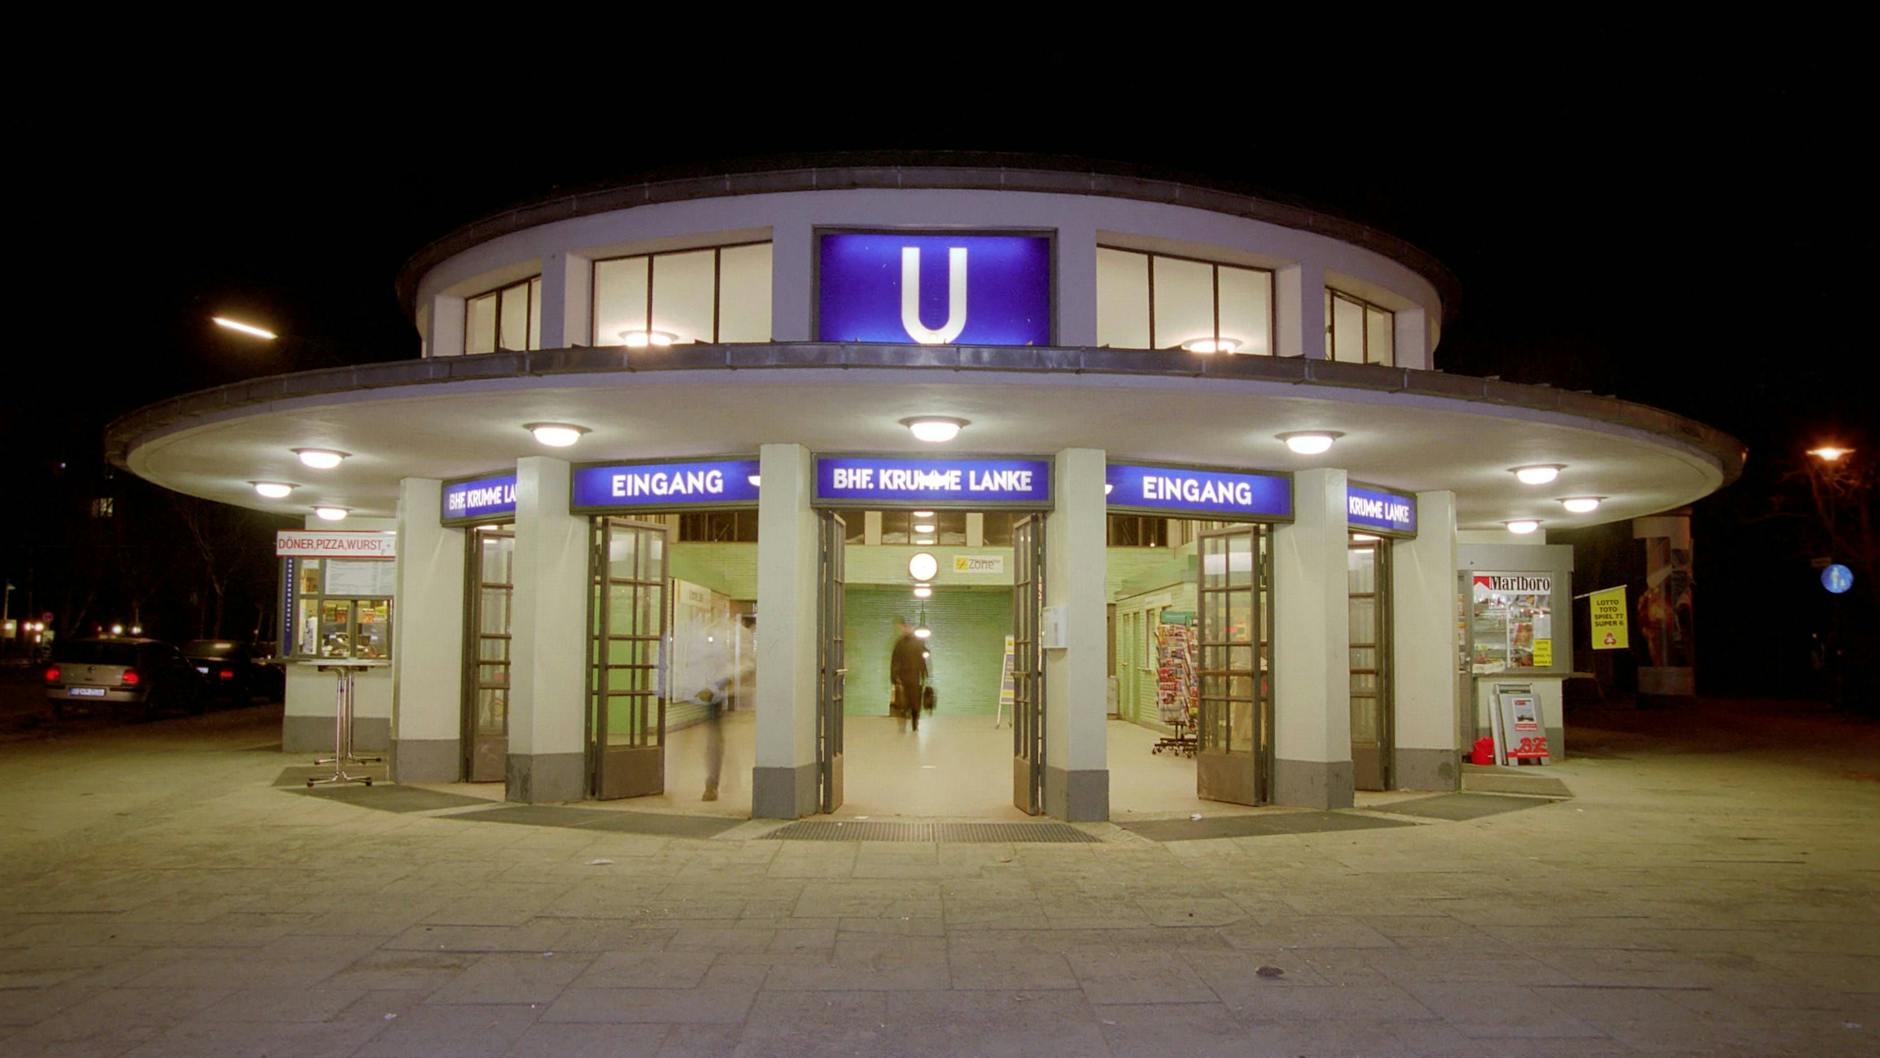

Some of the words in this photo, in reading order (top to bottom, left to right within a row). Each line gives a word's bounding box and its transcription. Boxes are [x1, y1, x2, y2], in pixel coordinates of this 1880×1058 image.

[902, 247, 967, 344] U
[612, 470, 723, 497] EINGANG
[833, 468, 874, 490] BHF.
[879, 469, 962, 491] KRUMME
[969, 470, 1032, 491] LANKE
[1143, 476, 1252, 505] EINGANG
[467, 486, 502, 508] KRUMME
[504, 483, 517, 503] LA
[1349, 496, 1383, 519] KRUMME
[1385, 502, 1409, 523] LANKE
[1489, 576, 1550, 591] Marlboro
